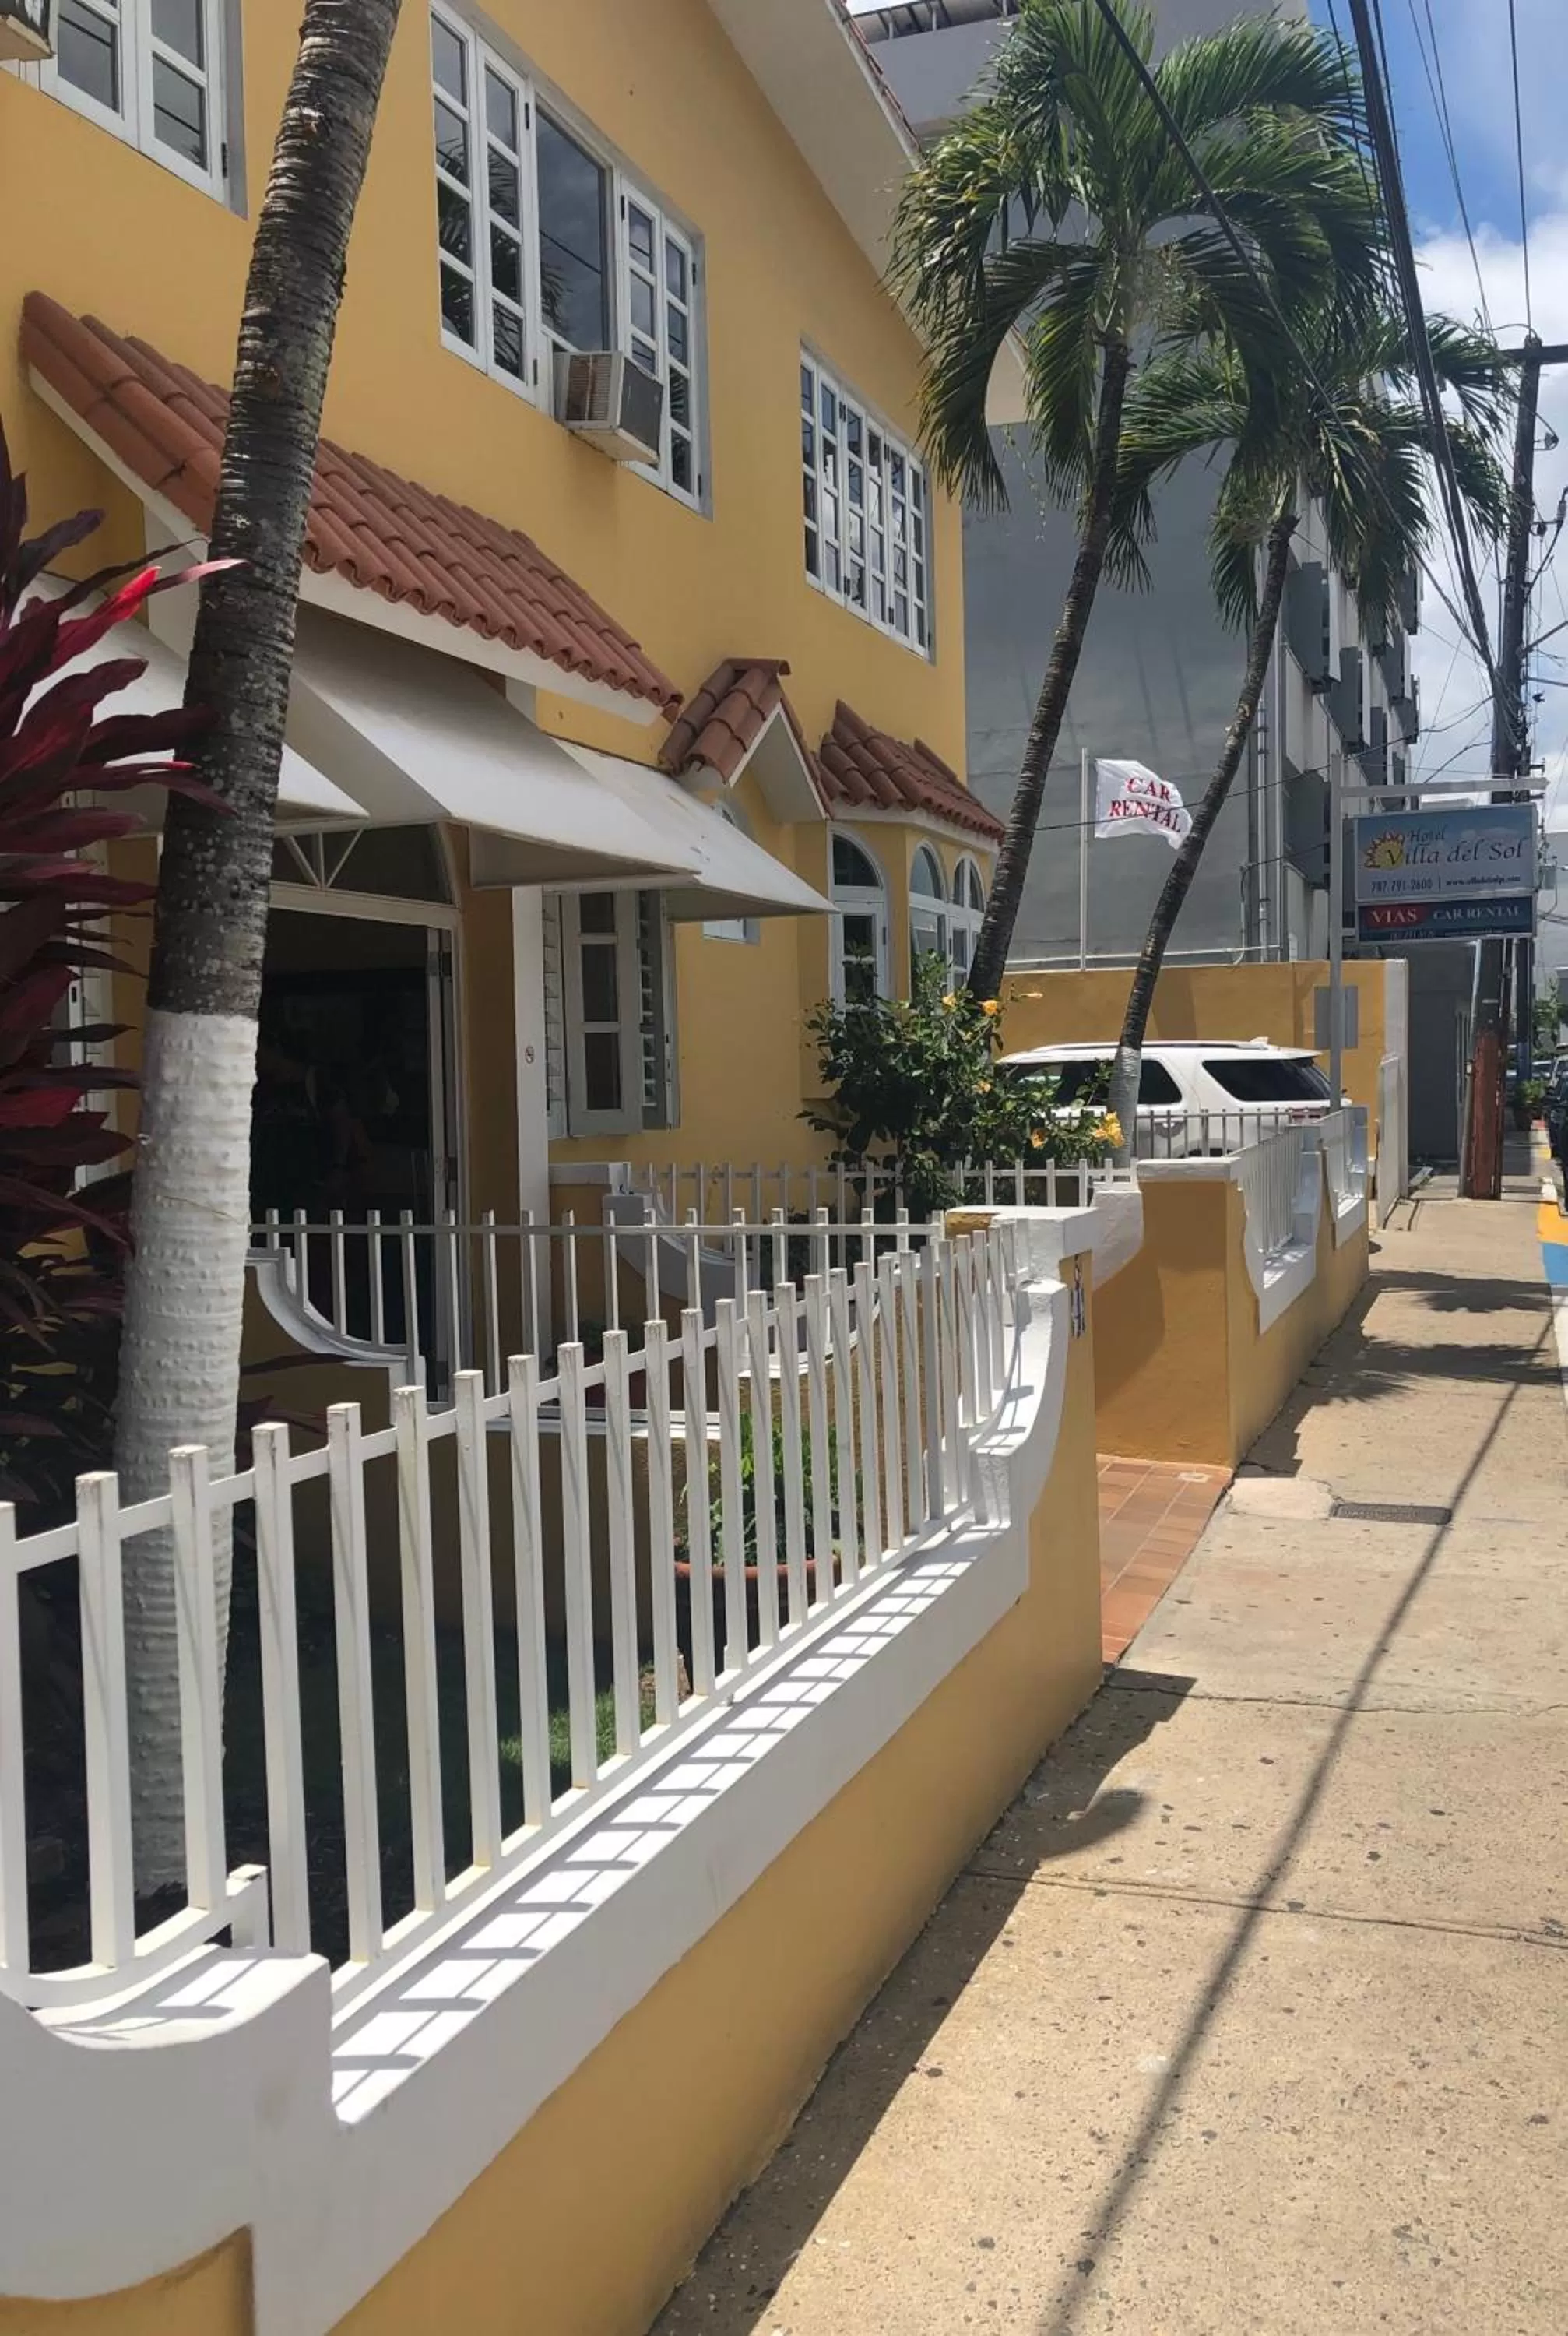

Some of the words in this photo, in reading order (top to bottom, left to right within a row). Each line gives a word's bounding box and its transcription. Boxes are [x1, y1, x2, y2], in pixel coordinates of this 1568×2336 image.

[1126, 776, 1171, 802] CAR
[1109, 800, 1181, 832] RENTAL
[1408, 824, 1446, 843] Hotel
[1386, 843, 1440, 865] Villa
[1447, 839, 1483, 863] del
[1488, 836, 1529, 860] Sol
[1371, 908, 1418, 923] VIAS
[1433, 909, 1464, 920] CAR
[1467, 905, 1520, 919] RENTAL
